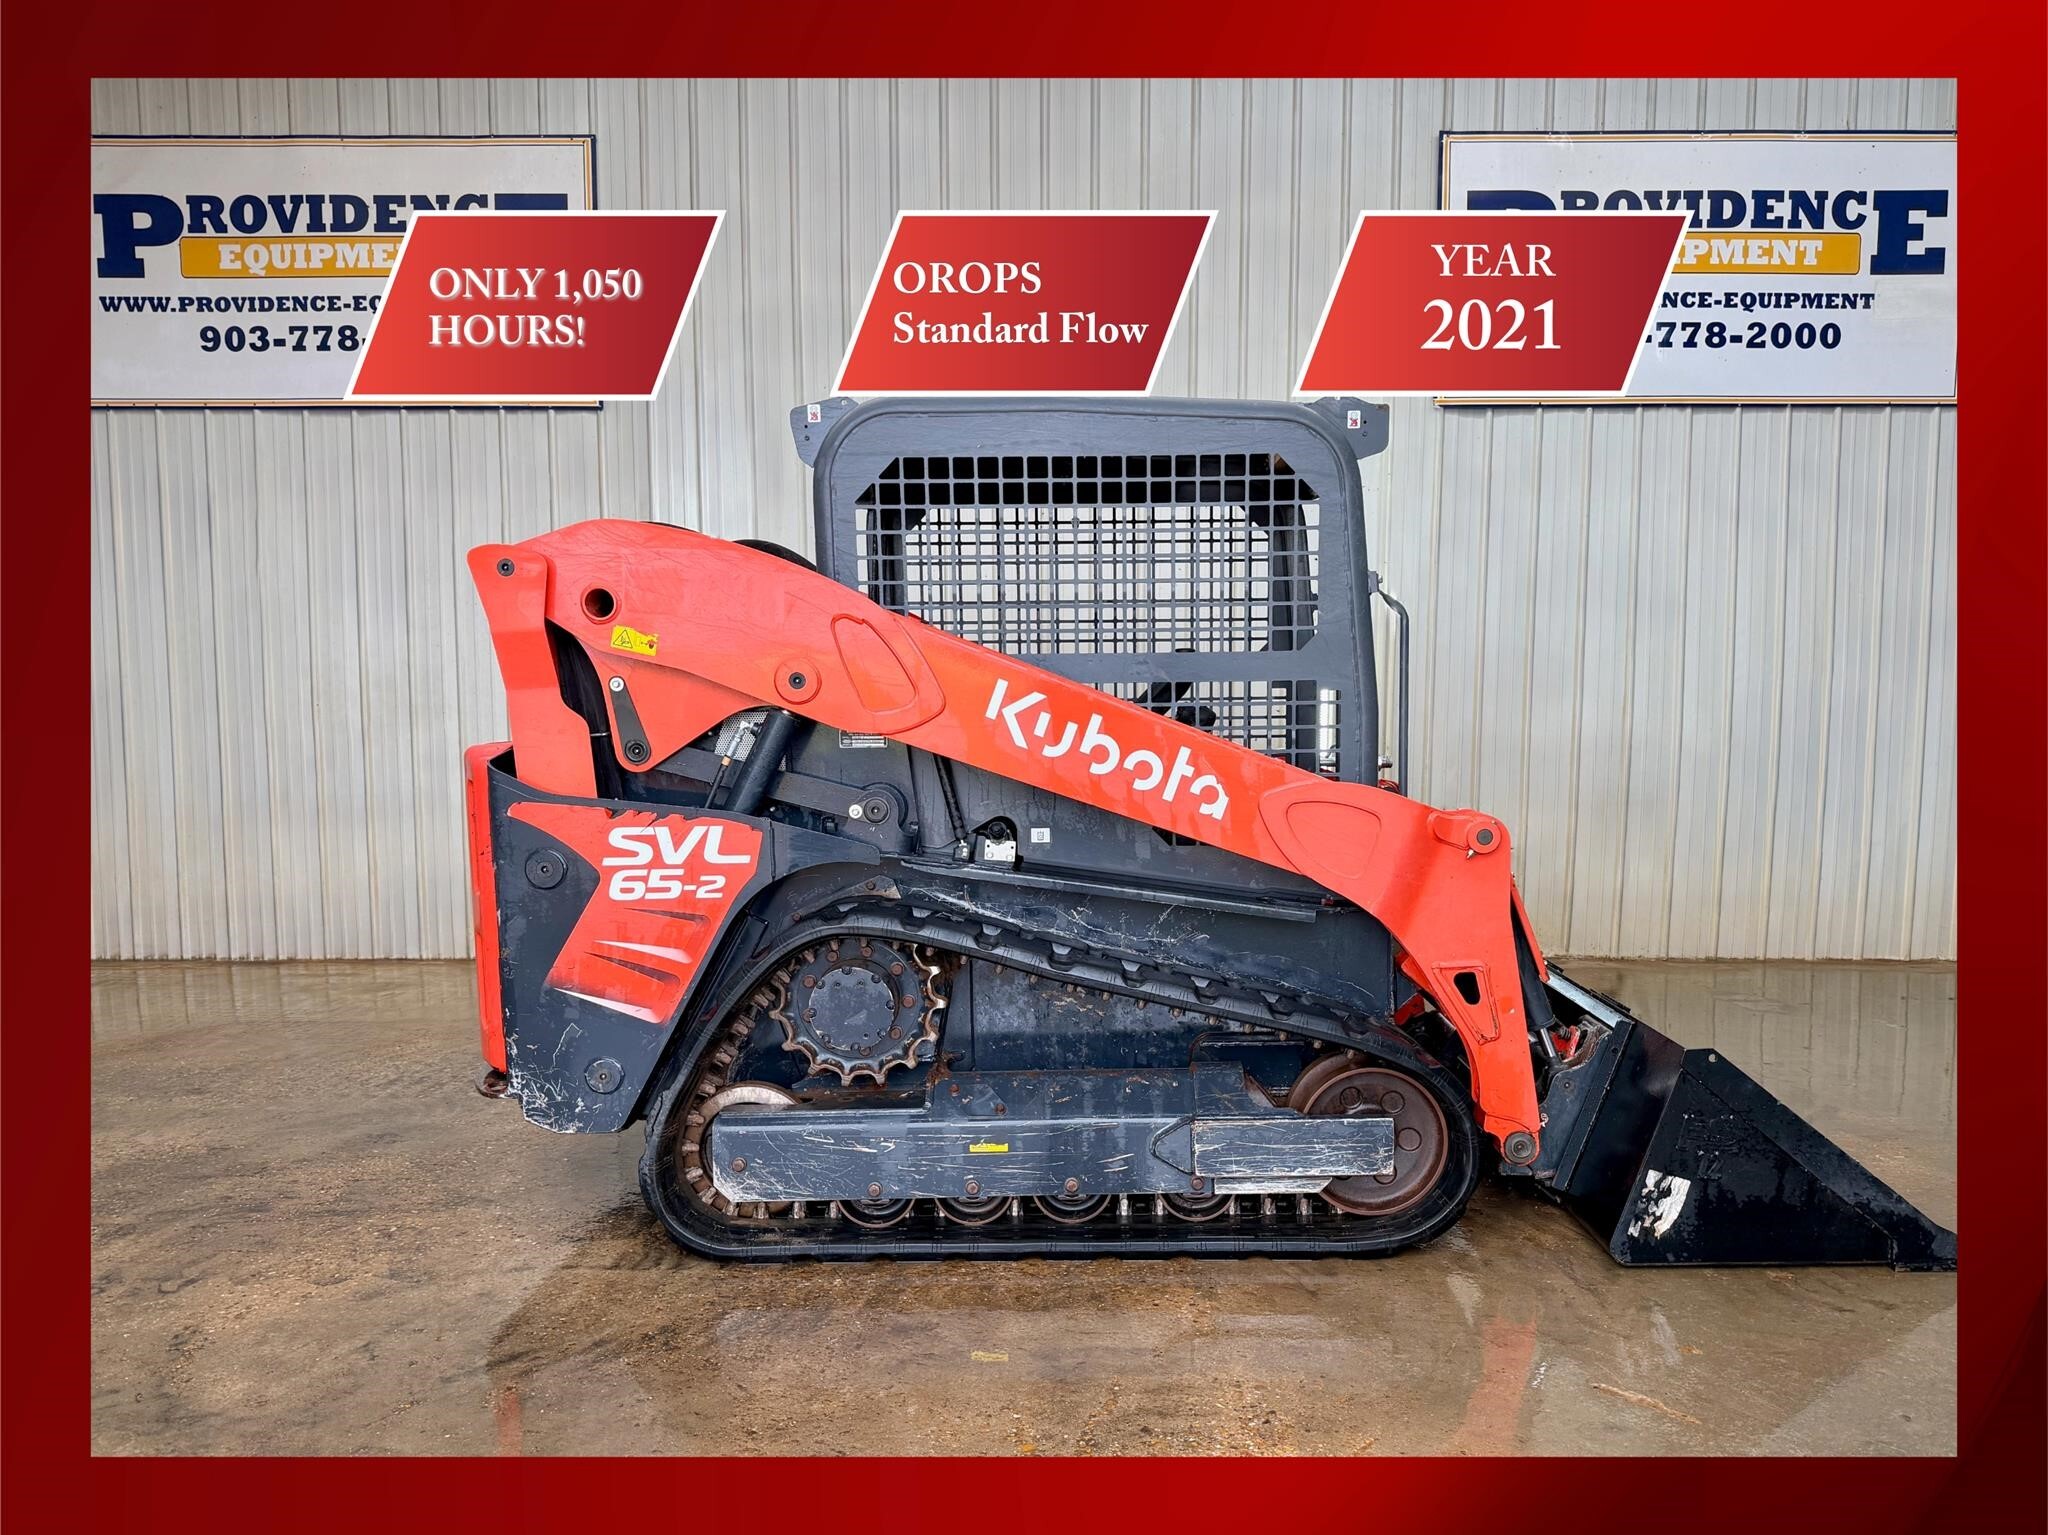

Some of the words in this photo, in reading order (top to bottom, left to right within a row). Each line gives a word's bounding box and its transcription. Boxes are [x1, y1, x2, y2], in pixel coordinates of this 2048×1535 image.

[93, 193, 568, 279] PROVIDE
[1676, 238, 1823, 266] PMENT
[219, 243, 401, 276] EQUIPME
[985, 678, 1231, 821] Kubota
[602, 825, 752, 867] SVL
[608, 868, 727, 901] 65-2
